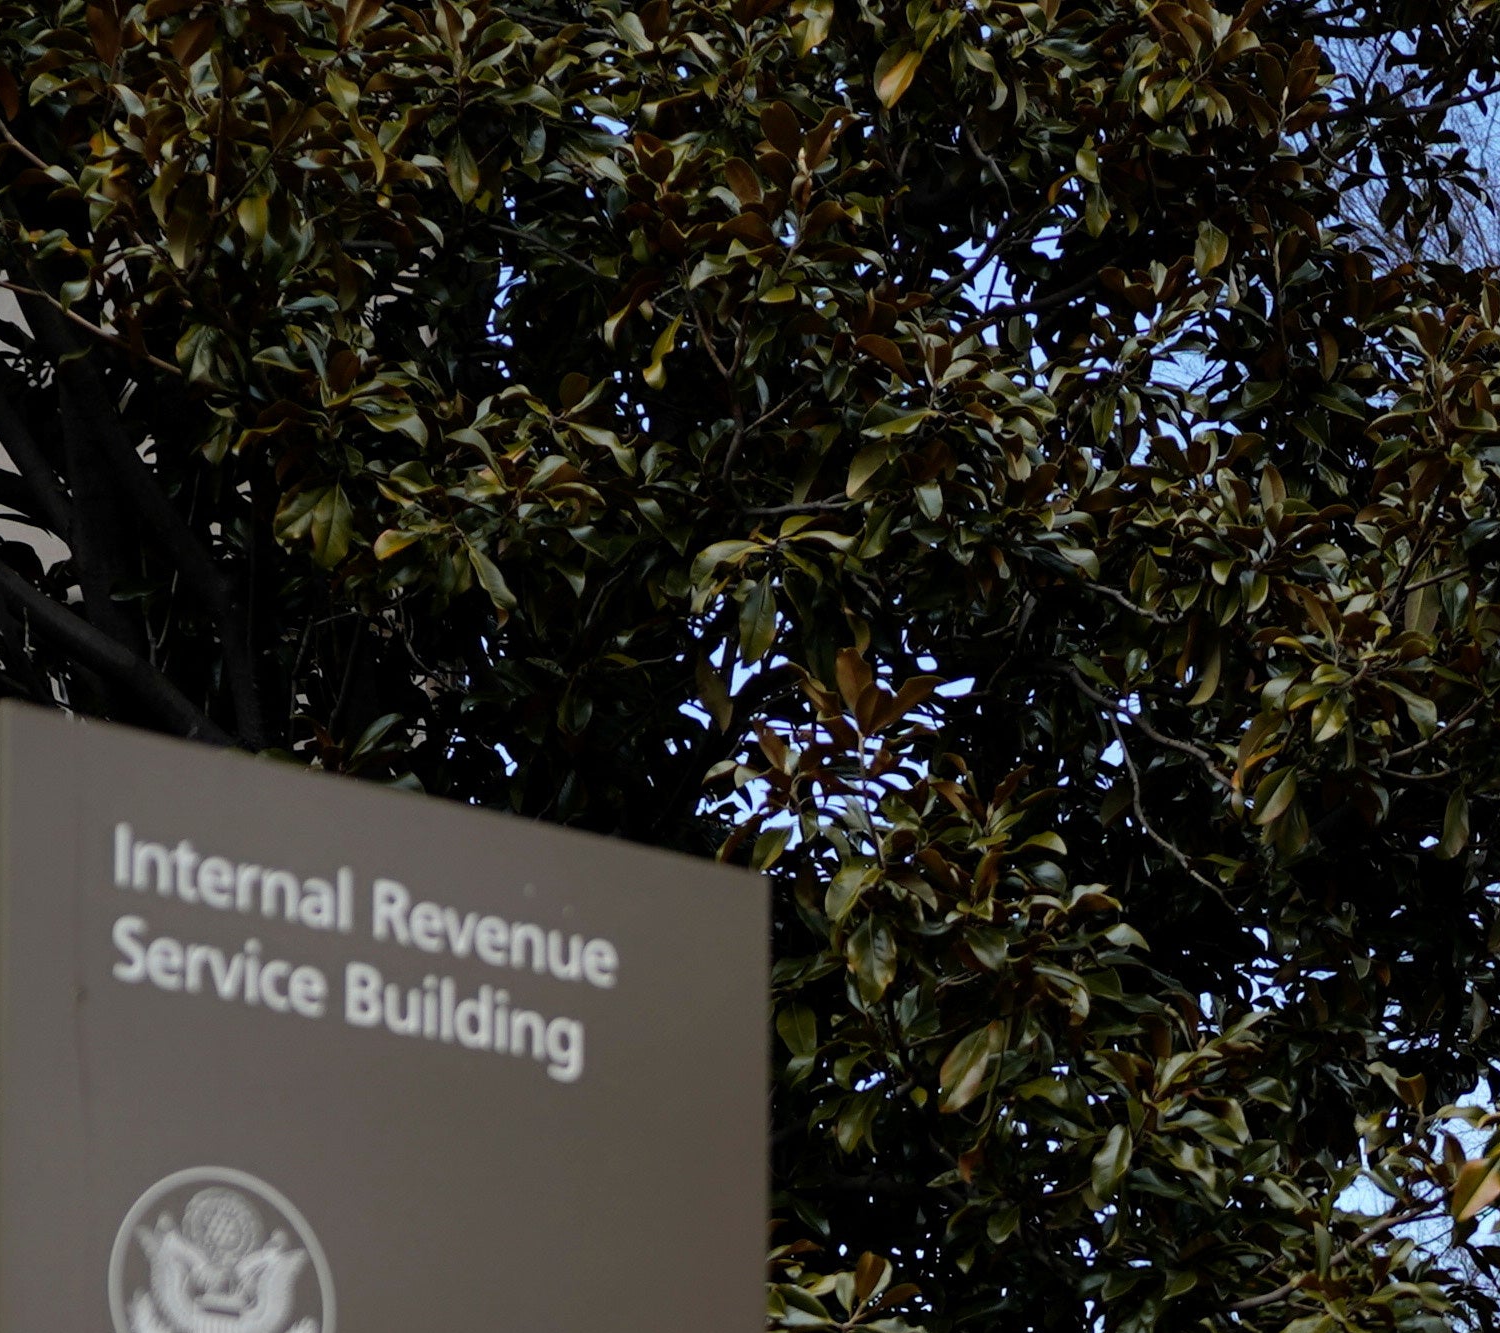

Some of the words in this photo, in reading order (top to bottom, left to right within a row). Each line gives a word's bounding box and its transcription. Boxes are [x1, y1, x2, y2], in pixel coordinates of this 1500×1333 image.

[112, 822, 354, 932] Internal
[372, 878, 619, 990] Revenue
[111, 915, 327, 1018] Service
[345, 961, 585, 1083] Building
